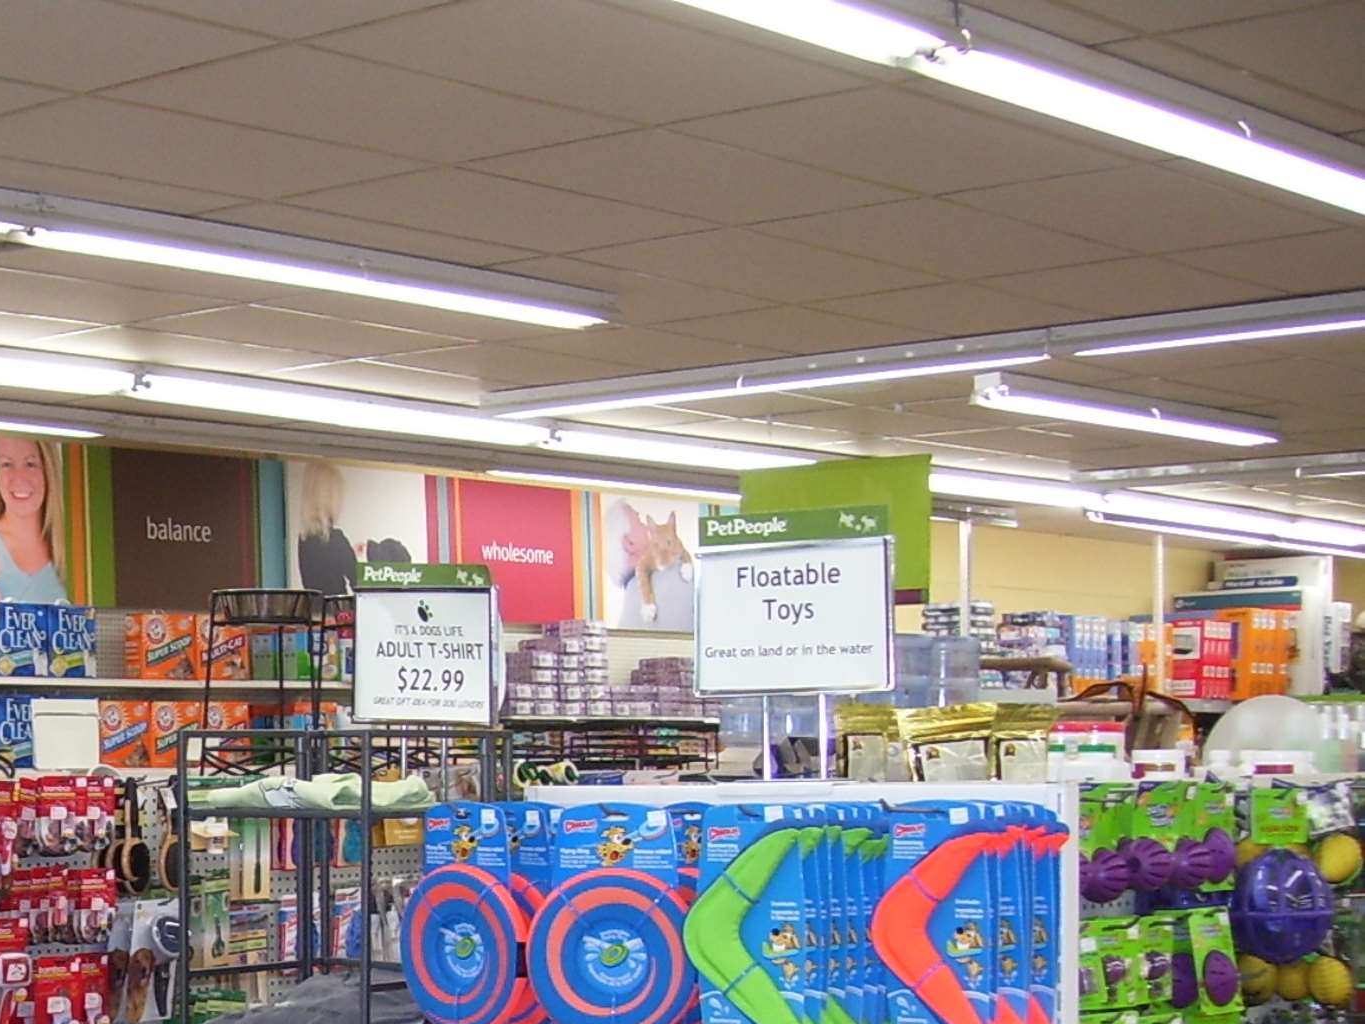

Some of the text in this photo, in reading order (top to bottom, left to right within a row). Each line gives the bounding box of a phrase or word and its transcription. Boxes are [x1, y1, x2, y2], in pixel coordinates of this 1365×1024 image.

[146, 515, 212, 543] balance
[706, 517, 788, 537] PetPeople
[481, 540, 554, 565] wholesome
[363, 565, 422, 585] PetPeople
[736, 562, 842, 588] Floatable
[762, 598, 815, 625] Toys
[444, 626, 464, 638] LIFE
[376, 641, 484, 661] ADULT T-SHIRT
[704, 644, 873, 658] Great on land or in the water
[397, 665, 465, 693] $22.99
